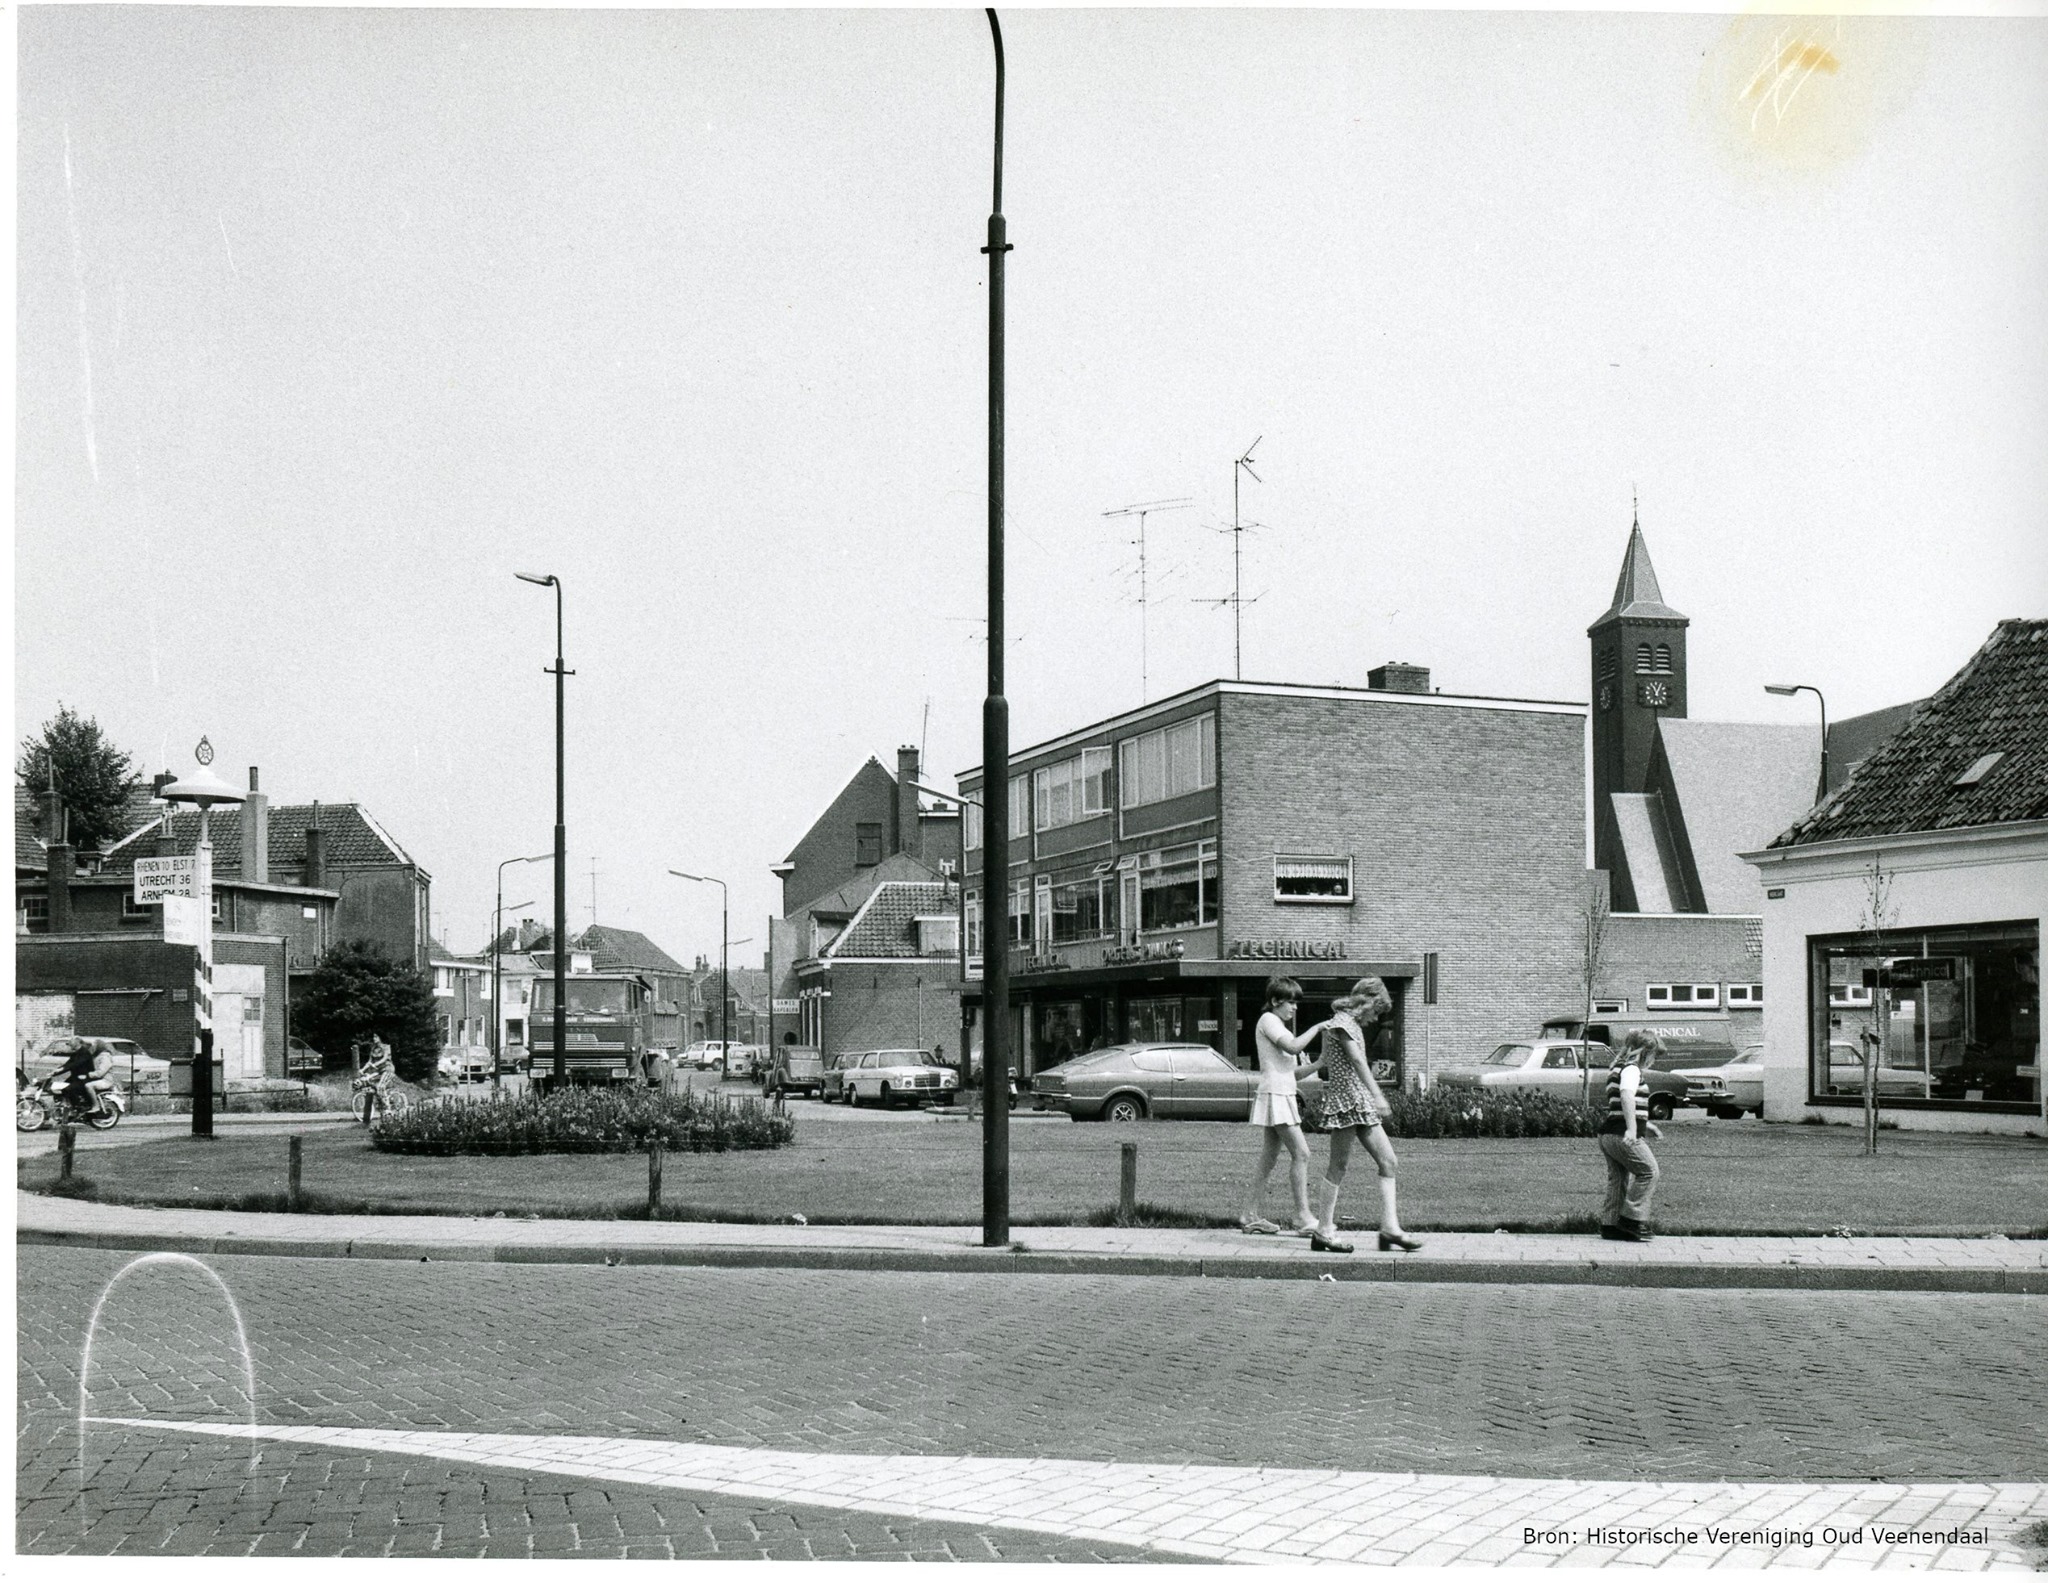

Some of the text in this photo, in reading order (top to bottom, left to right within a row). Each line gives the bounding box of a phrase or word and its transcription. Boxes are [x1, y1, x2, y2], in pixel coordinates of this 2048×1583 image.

[136, 861, 160, 872] RHENEN
[162, 861, 170, 871] 10
[173, 859, 188, 871] ELST
[139, 874, 191, 887] UTRECHT 36
[178, 889, 190, 897] 28
[1234, 938, 1347, 958] TECHNICAL
[1629, 1027, 1701, 1038] HNICAL
